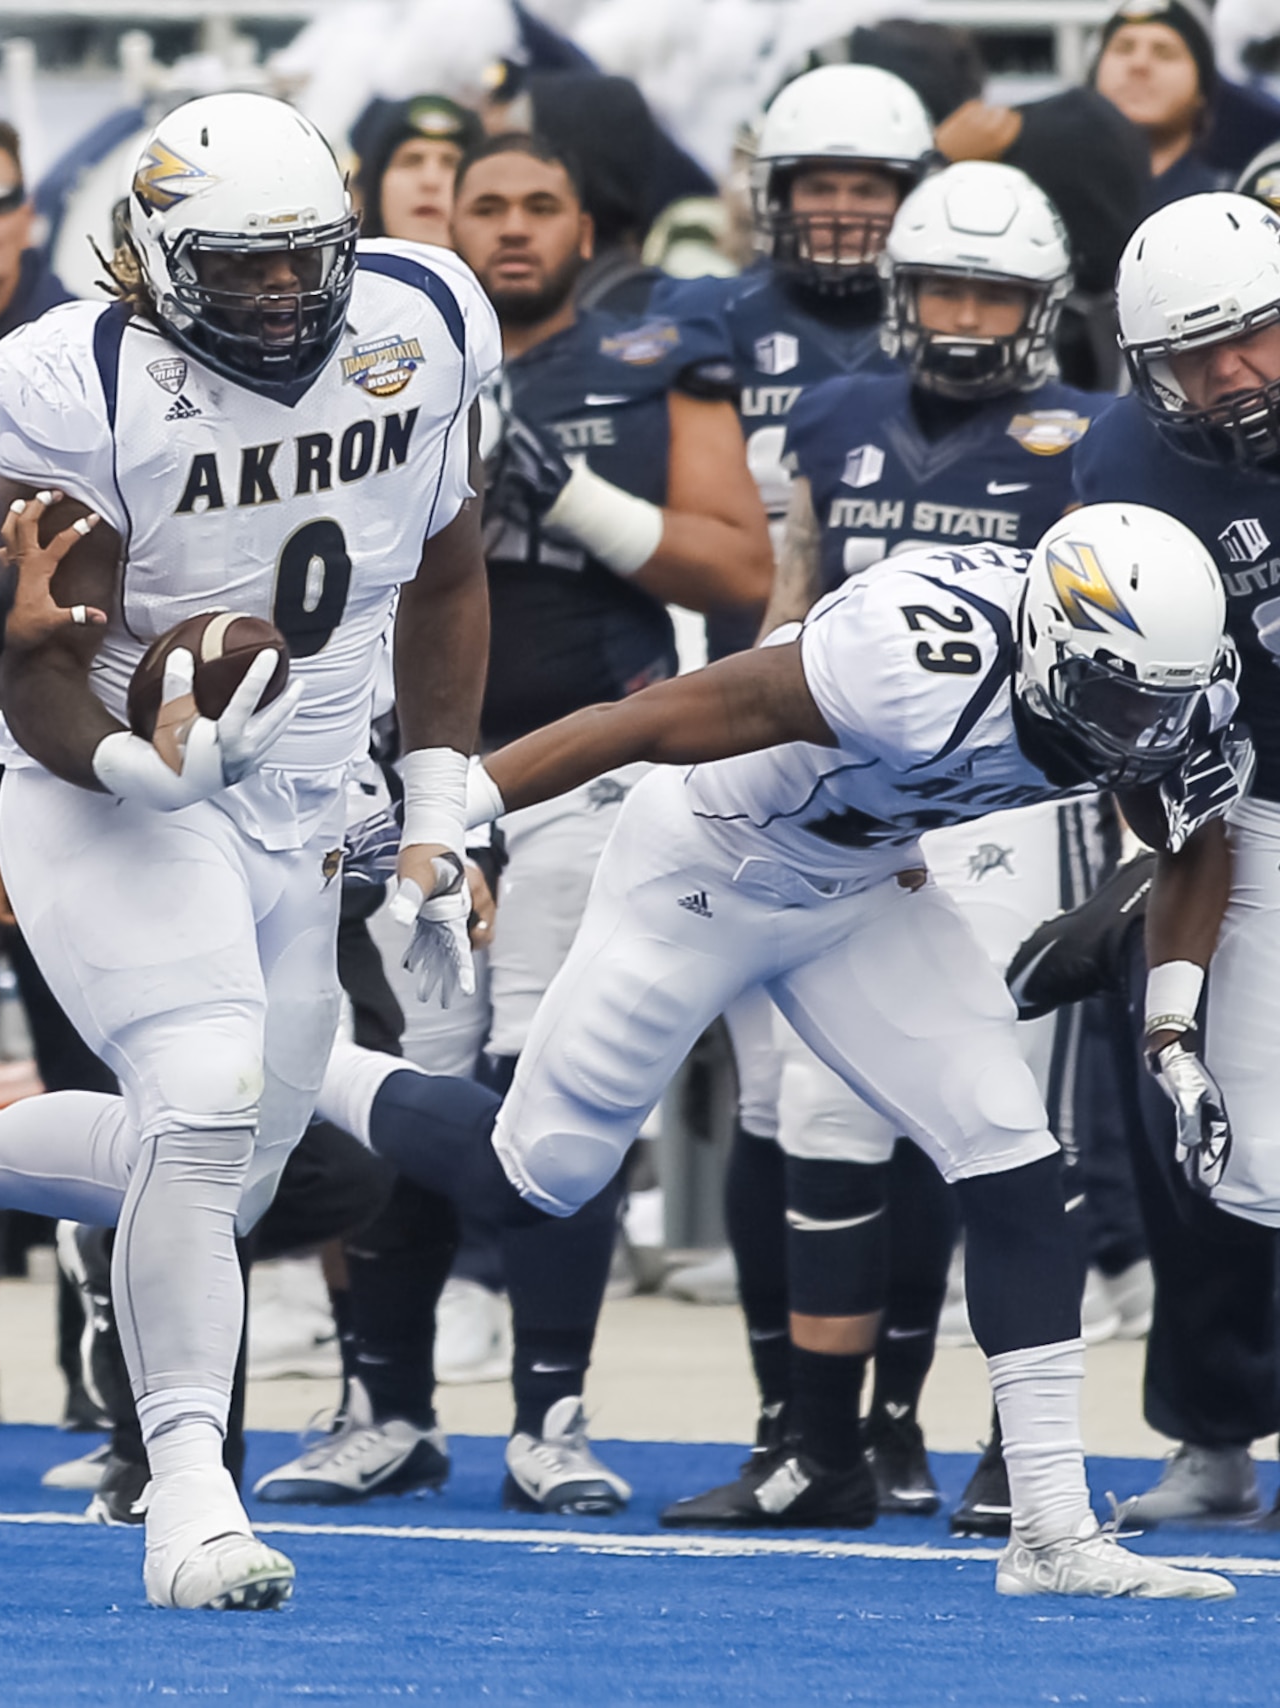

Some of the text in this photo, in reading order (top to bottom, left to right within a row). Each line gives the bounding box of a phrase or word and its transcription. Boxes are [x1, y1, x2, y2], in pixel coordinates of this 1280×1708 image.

[367, 369, 409, 389] BOWL
[171, 404, 420, 517] AKRON
[912, 501, 1020, 541] STATE
[273, 516, 352, 659] 0
[899, 604, 982, 675] 29
